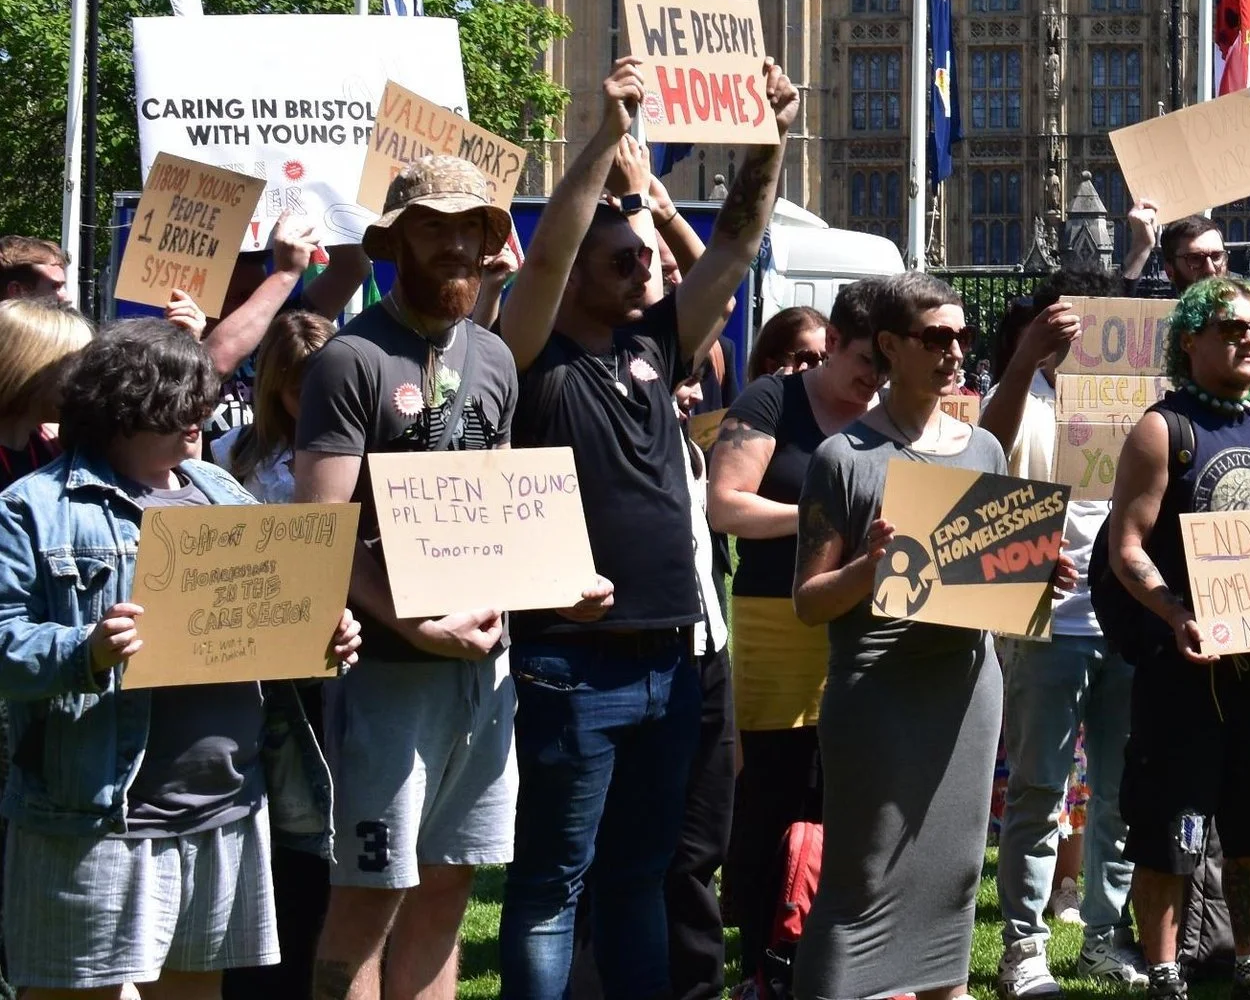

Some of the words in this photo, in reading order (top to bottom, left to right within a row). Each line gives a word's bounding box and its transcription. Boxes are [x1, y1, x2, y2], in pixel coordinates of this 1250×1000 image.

[637, 4, 688, 56] WE
[690, 10, 758, 58] DESERVE
[141, 98, 245, 121] CARING
[252, 98, 278, 119] IN
[285, 99, 376, 121] BRISTOL
[655, 65, 765, 127] HOMES
[186, 125, 250, 146] WITH
[256, 124, 346, 146] YOUNG
[384, 87, 457, 154] VALUE
[458, 129, 520, 183] WORK?
[194, 172, 245, 207] YOUNG
[168, 194, 221, 230] PEOPLE
[138, 209, 154, 243] 1
[158, 223, 219, 259] BROKEN
[141, 253, 207, 298] SYSTEM
[1077, 373, 1147, 409] need
[387, 476, 483, 502] HELPIN
[501, 472, 578, 500] YOUNG
[393, 506, 422, 524] PPL
[435, 504, 490, 524] LIVE
[503, 499, 545, 524] FOR
[934, 516, 970, 546] END
[975, 484, 1035, 522] YOUTH
[938, 490, 1064, 567] HOMELESSNESS
[416, 538, 503, 558] Tomorrow
[980, 531, 1063, 582] NOW
[241, 575, 282, 600] THE
[188, 607, 243, 636] CARE
[246, 597, 311, 629] SECTOR
[356, 820, 389, 872] 3
